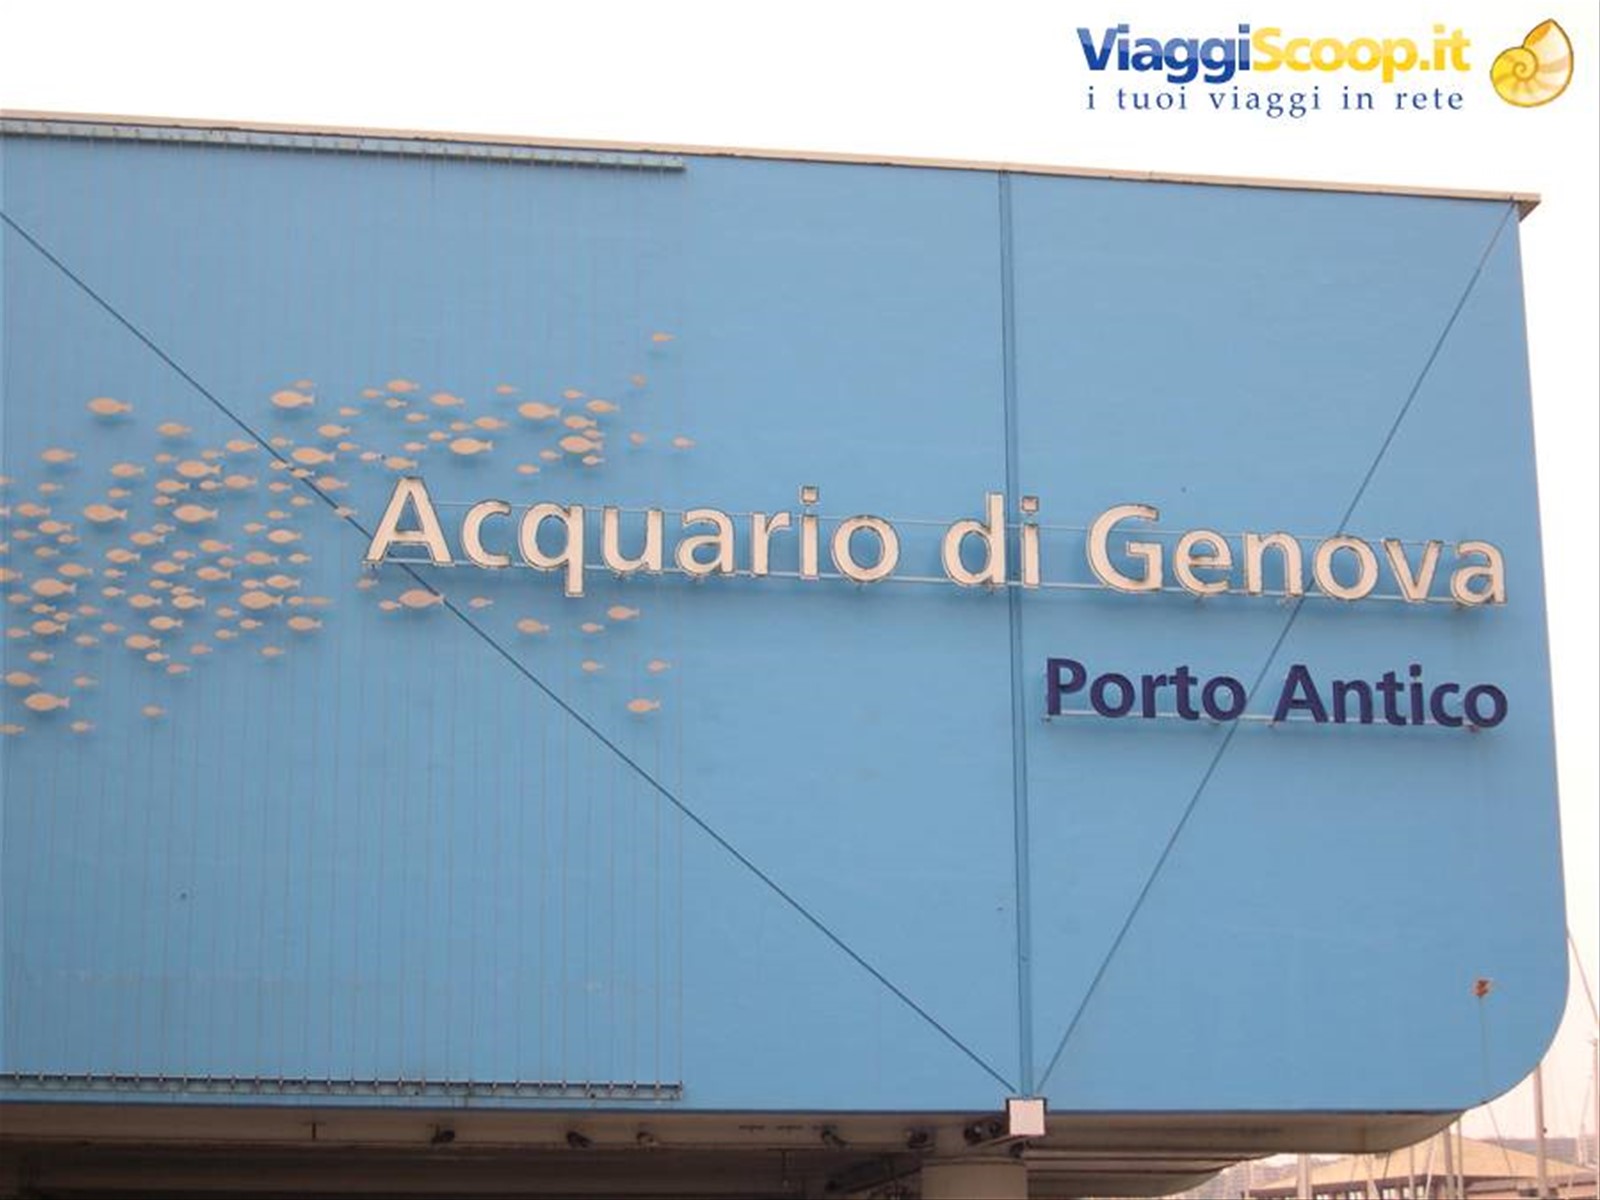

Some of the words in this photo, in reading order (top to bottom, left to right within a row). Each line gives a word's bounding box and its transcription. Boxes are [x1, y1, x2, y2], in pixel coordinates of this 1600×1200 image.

[363, 476, 900, 598] Acquario
[940, 491, 1040, 589] di
[1087, 503, 1508, 606] Genova
[1045, 657, 1247, 721] Porto
[1272, 663, 1508, 728] Antico
